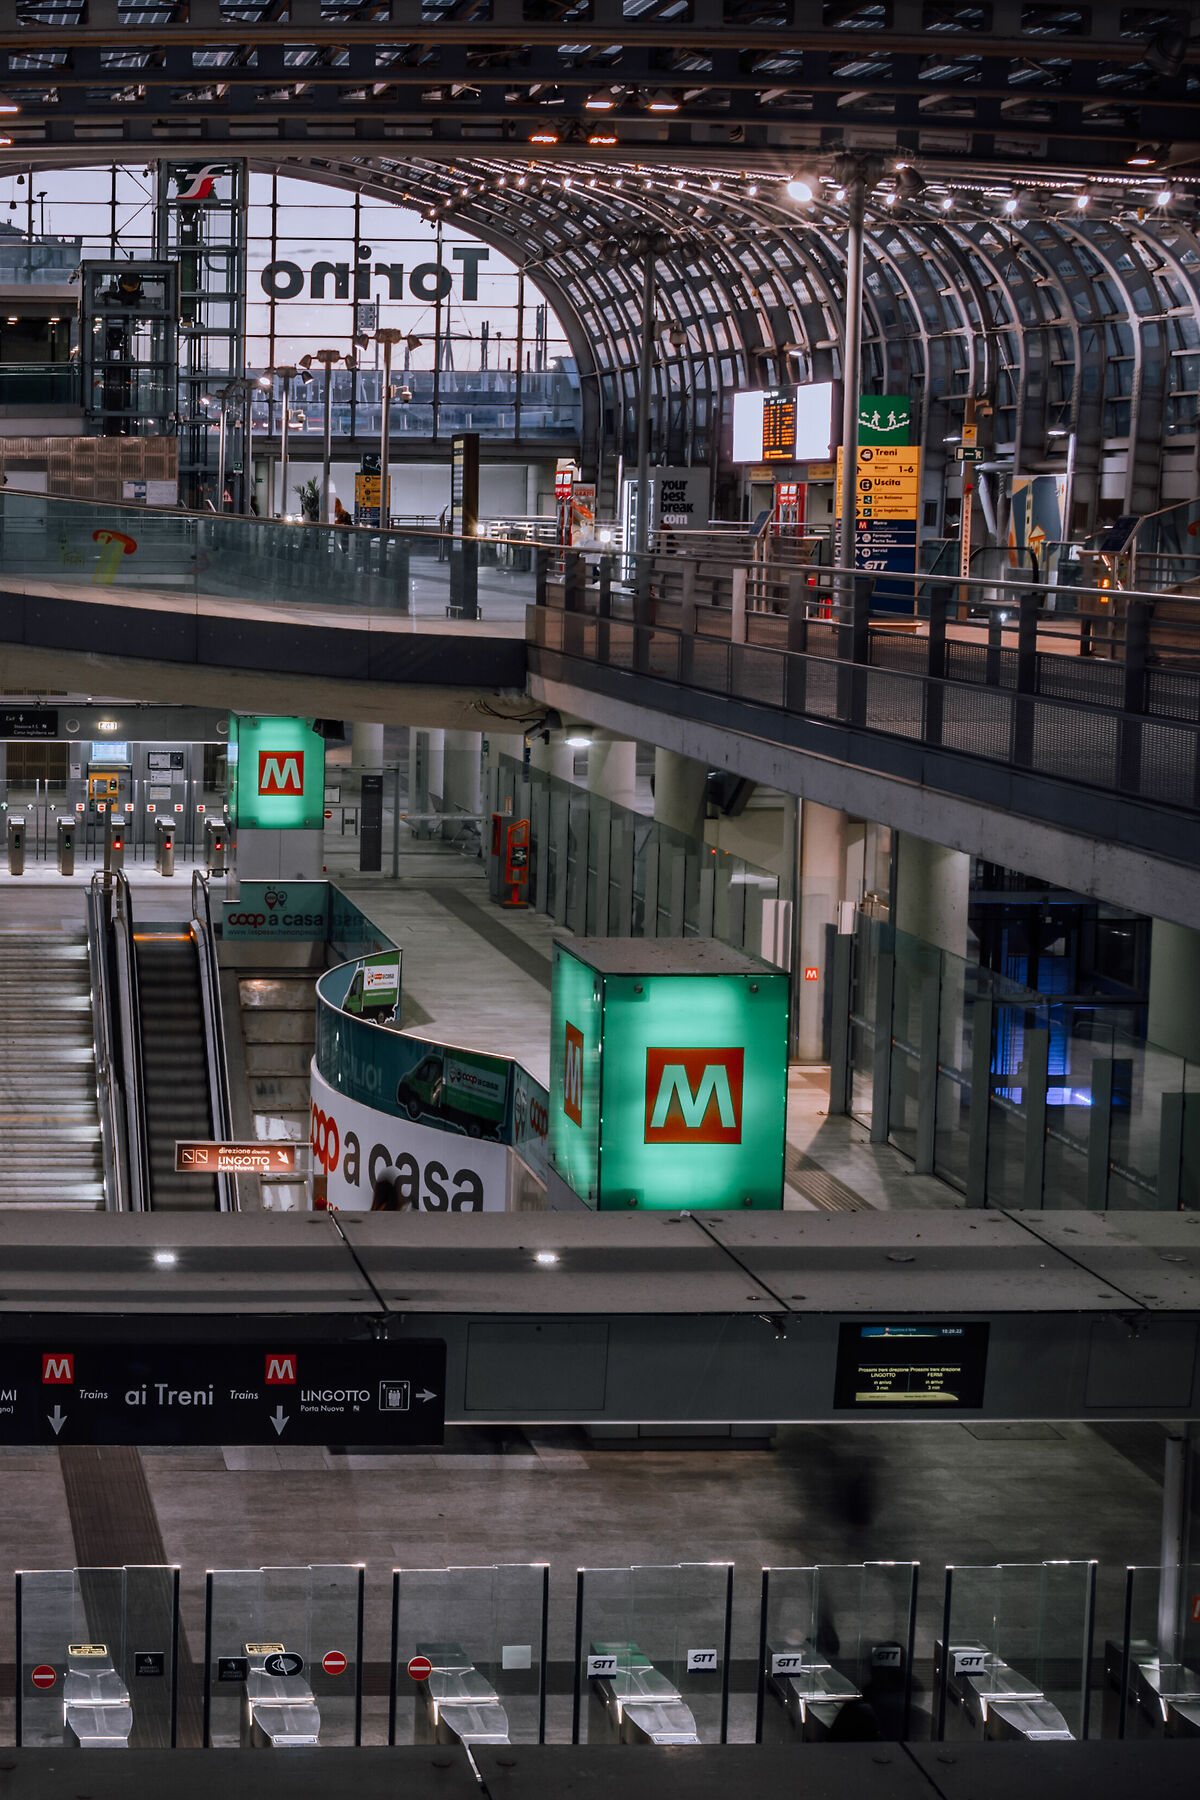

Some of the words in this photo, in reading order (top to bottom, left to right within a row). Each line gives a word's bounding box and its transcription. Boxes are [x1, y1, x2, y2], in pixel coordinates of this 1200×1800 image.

[875, 449, 898, 457] Treni
[662, 480, 688, 491] your
[661, 491, 685, 502] best
[661, 502, 694, 513] break
[862, 560, 888, 570] GTT
[260, 758, 302, 789] M
[228, 913, 266, 928] coop
[268, 915, 278, 926] a
[282, 915, 323, 926] casa
[806, 969, 817, 979] M
[462, 1073, 478, 1085] coop
[565, 1040, 582, 1111] M
[650, 1064, 737, 1129] M
[530, 1097, 548, 1141] coop
[310, 1096, 339, 1176] oop
[344, 1131, 360, 1187] a
[368, 1144, 484, 1211] casa
[218, 1157, 270, 1165] LINGOTTO
[44, 1359, 71, 1378] M
[267, 1360, 294, 1379] M
[79, 1390, 108, 1400] Trains
[125, 1384, 147, 1406] ai
[154, 1384, 214, 1406] Treni
[230, 1390, 259, 1400] Trains
[300, 1390, 370, 1402] LINGOTTO
[692, 1653, 715, 1663] GTT
[874, 1652, 899, 1661] GTT
[958, 1656, 982, 1667] GTT
[591, 1659, 616, 1669] GTT
[775, 1658, 800, 1668] GTT
